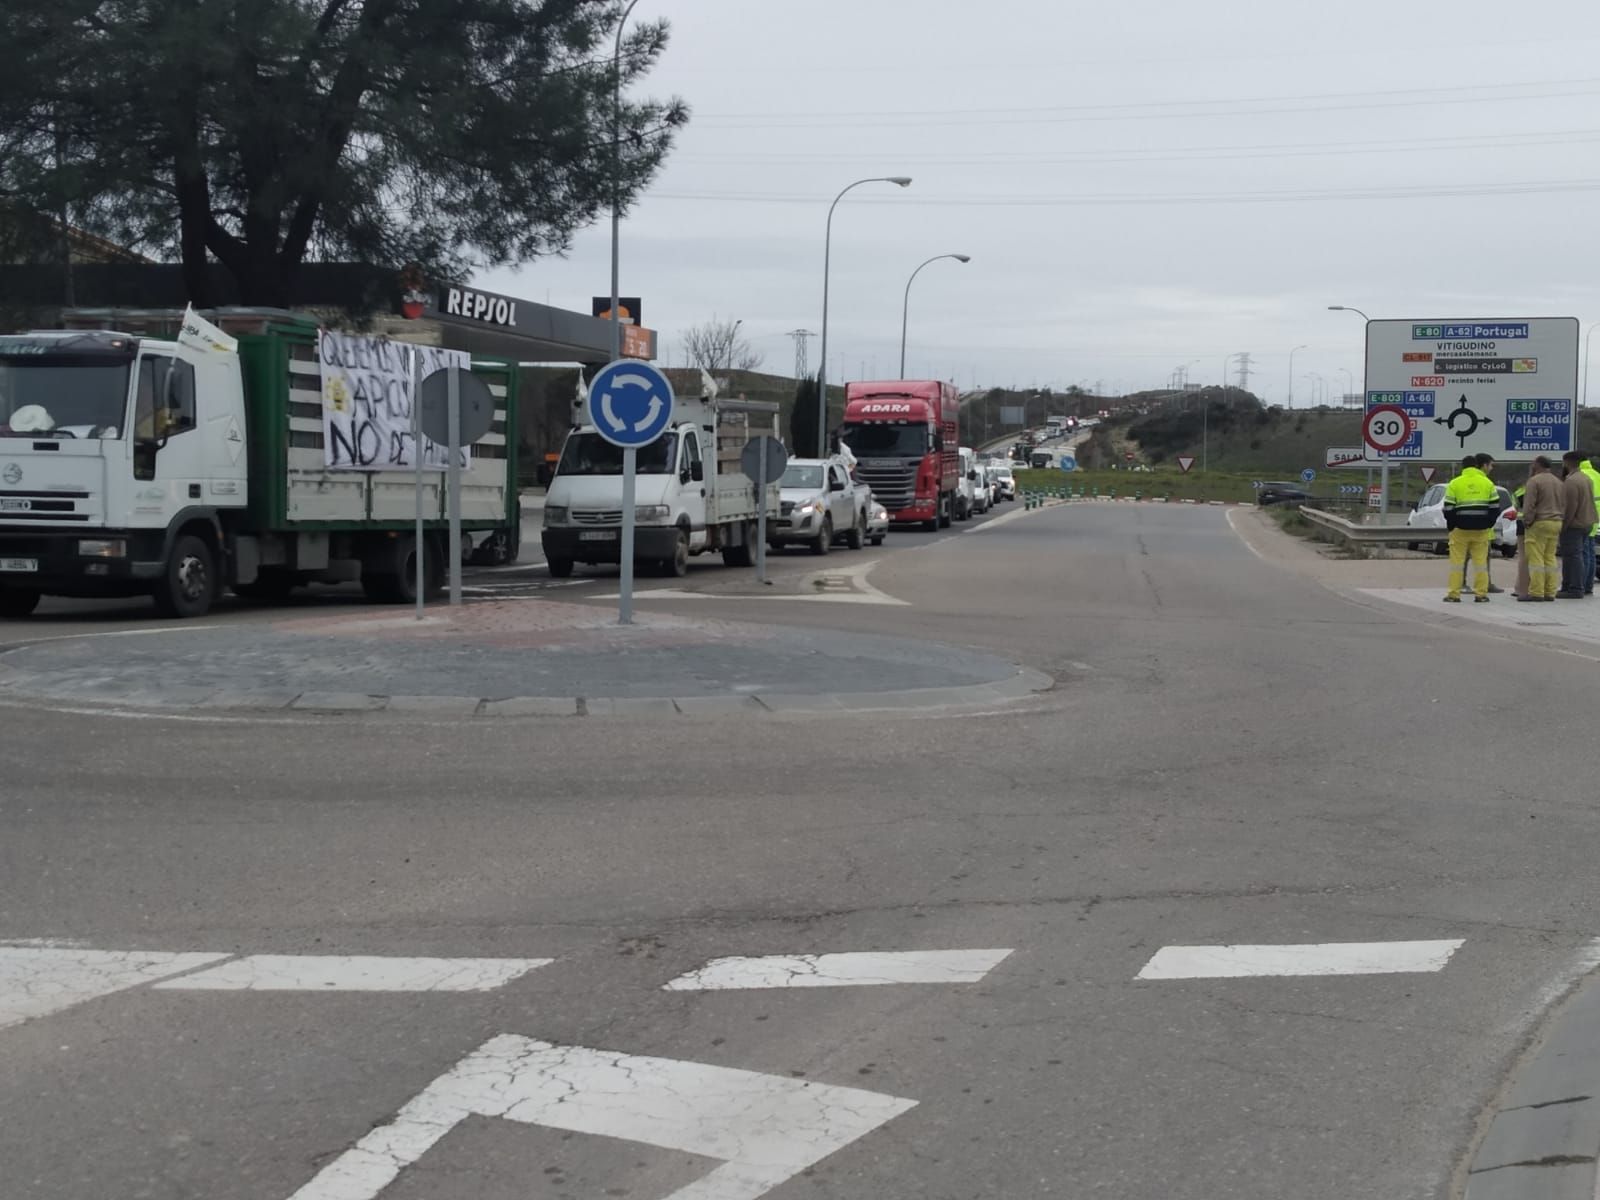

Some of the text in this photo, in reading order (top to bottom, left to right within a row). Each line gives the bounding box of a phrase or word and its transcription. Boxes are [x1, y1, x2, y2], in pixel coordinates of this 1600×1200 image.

[447, 287, 517, 326] REPSOL
[1415, 325, 1527, 338] E-80 A-62 Portugal
[1436, 341, 1496, 350] VITIGUDINO
[1412, 377, 1444, 386] N-620
[1371, 394, 1431, 402] E-803 A-66
[861, 404, 910, 413] ADARA
[1511, 402, 1567, 410] E-80 A-62
[1508, 414, 1569, 424] Valladolid
[1373, 420, 1399, 436] 30
[1526, 428, 1550, 436] A-66
[330, 419, 381, 466] NO
[1514, 440, 1560, 450] Zamora
[1379, 446, 1420, 456] adrid
